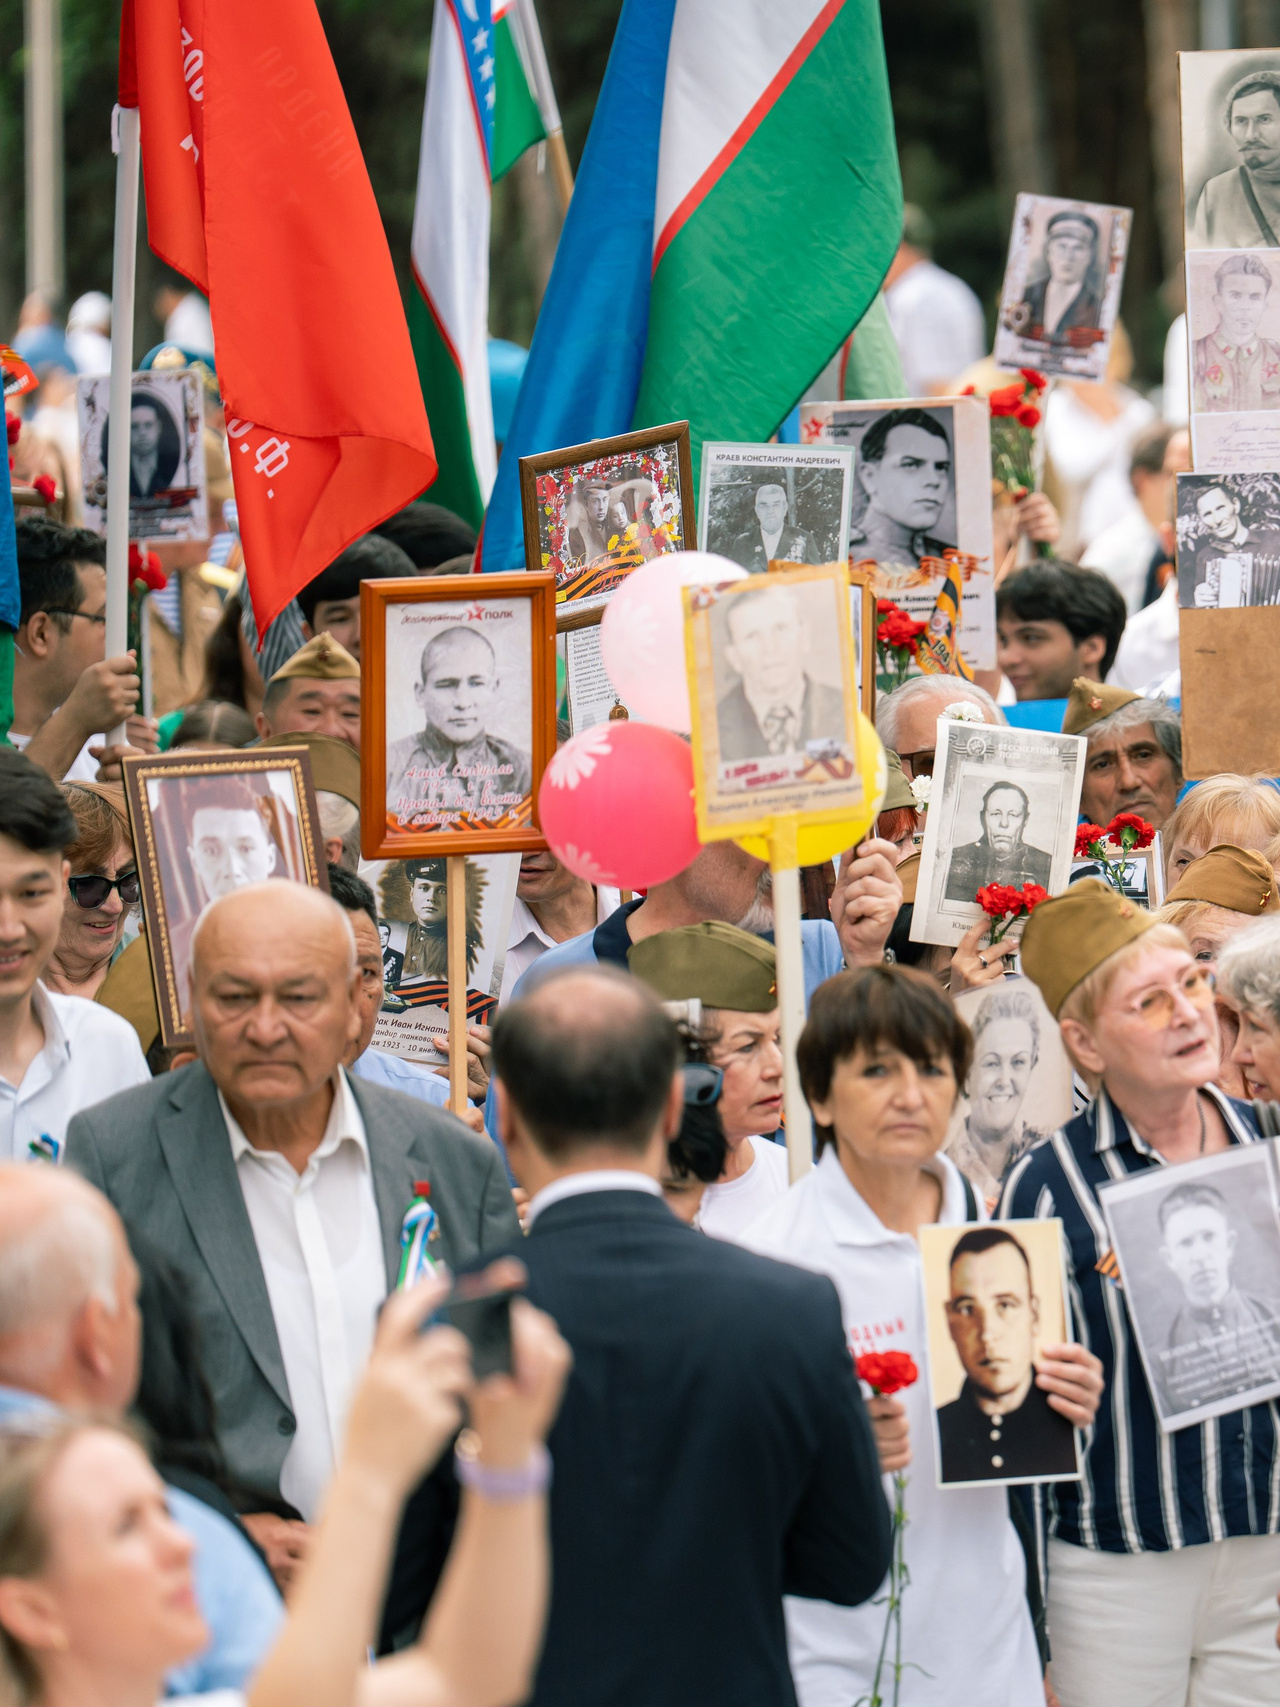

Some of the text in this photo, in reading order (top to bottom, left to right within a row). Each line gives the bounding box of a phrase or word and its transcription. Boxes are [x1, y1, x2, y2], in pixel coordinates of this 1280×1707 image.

[716, 453, 841, 465] КРАЕВ КОНСТАНТИН АНДРЕЕВИЧ
[390, 1018, 413, 1029] Иван
[414, 1022, 449, 1035] Игнать
[373, 1029, 398, 1039] андир
[382, 1040, 400, 1050] 1923
[407, 1044, 418, 1052] 10
